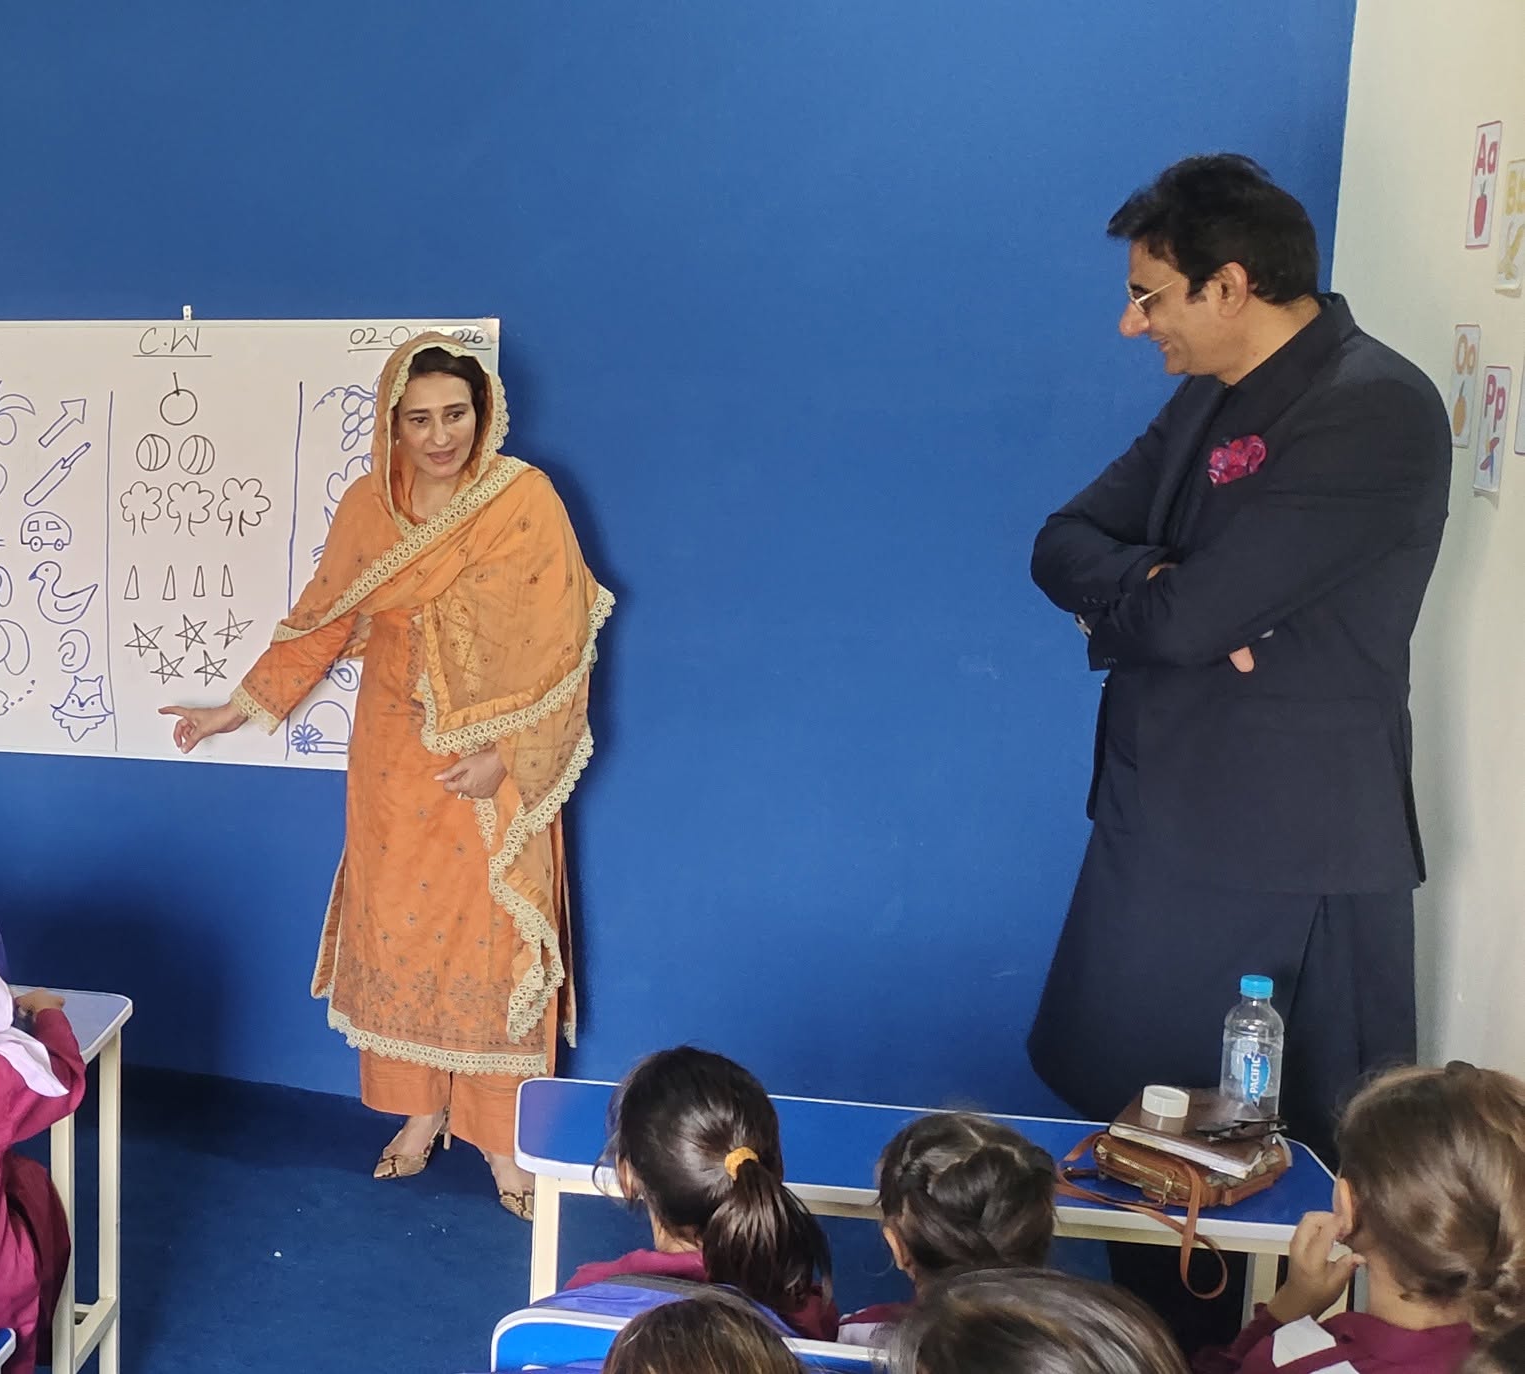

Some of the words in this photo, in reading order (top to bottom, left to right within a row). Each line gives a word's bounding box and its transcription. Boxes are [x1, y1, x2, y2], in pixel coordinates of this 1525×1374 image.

[1475, 133, 1498, 176] Aa
[139, 327, 199, 354] C.W
[1484, 374, 1506, 433] Pp
[1249, 1056, 1261, 1094] PACIFIC
